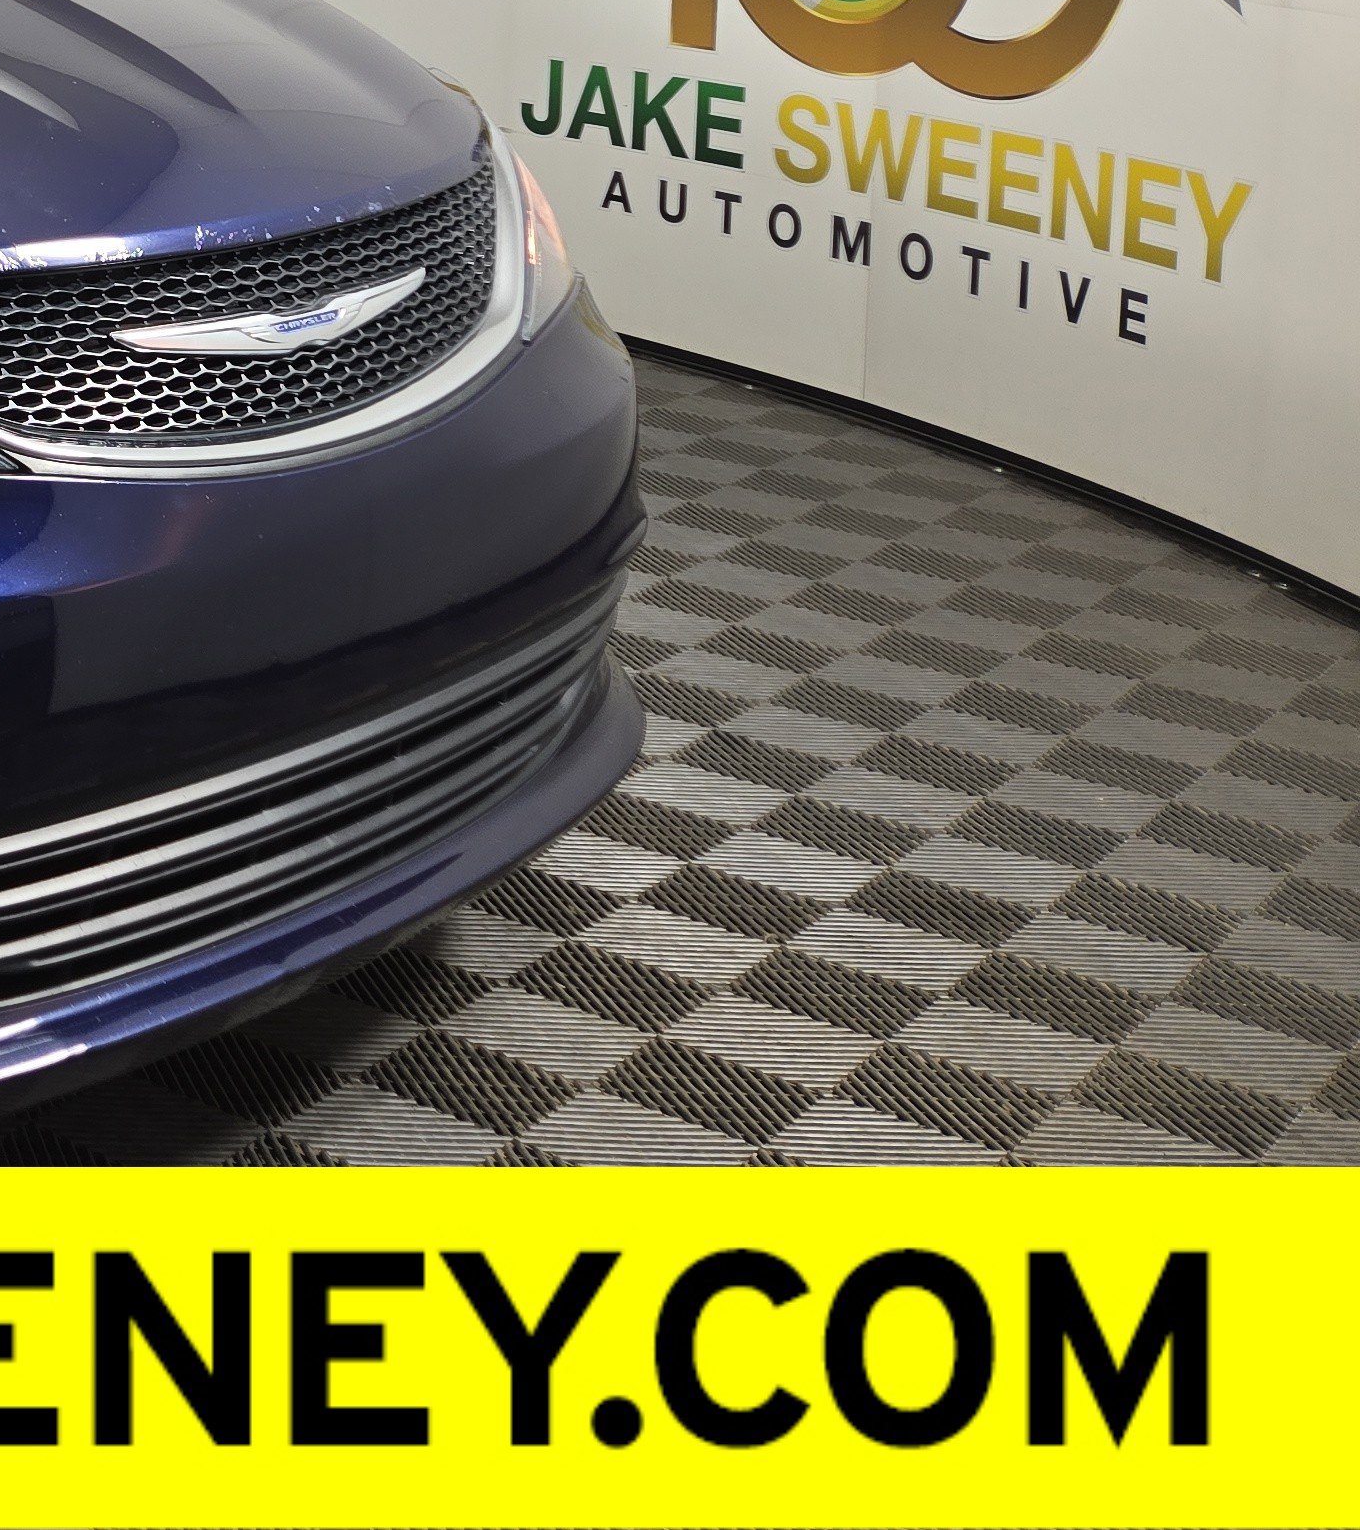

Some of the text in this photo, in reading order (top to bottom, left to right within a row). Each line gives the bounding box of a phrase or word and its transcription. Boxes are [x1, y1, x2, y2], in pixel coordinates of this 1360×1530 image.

[521, 59, 1253, 282] JAKE SWEENEY
[601, 170, 1150, 345] AUTOMOTIVE
[275, 312, 336, 331] CHRYSLER
